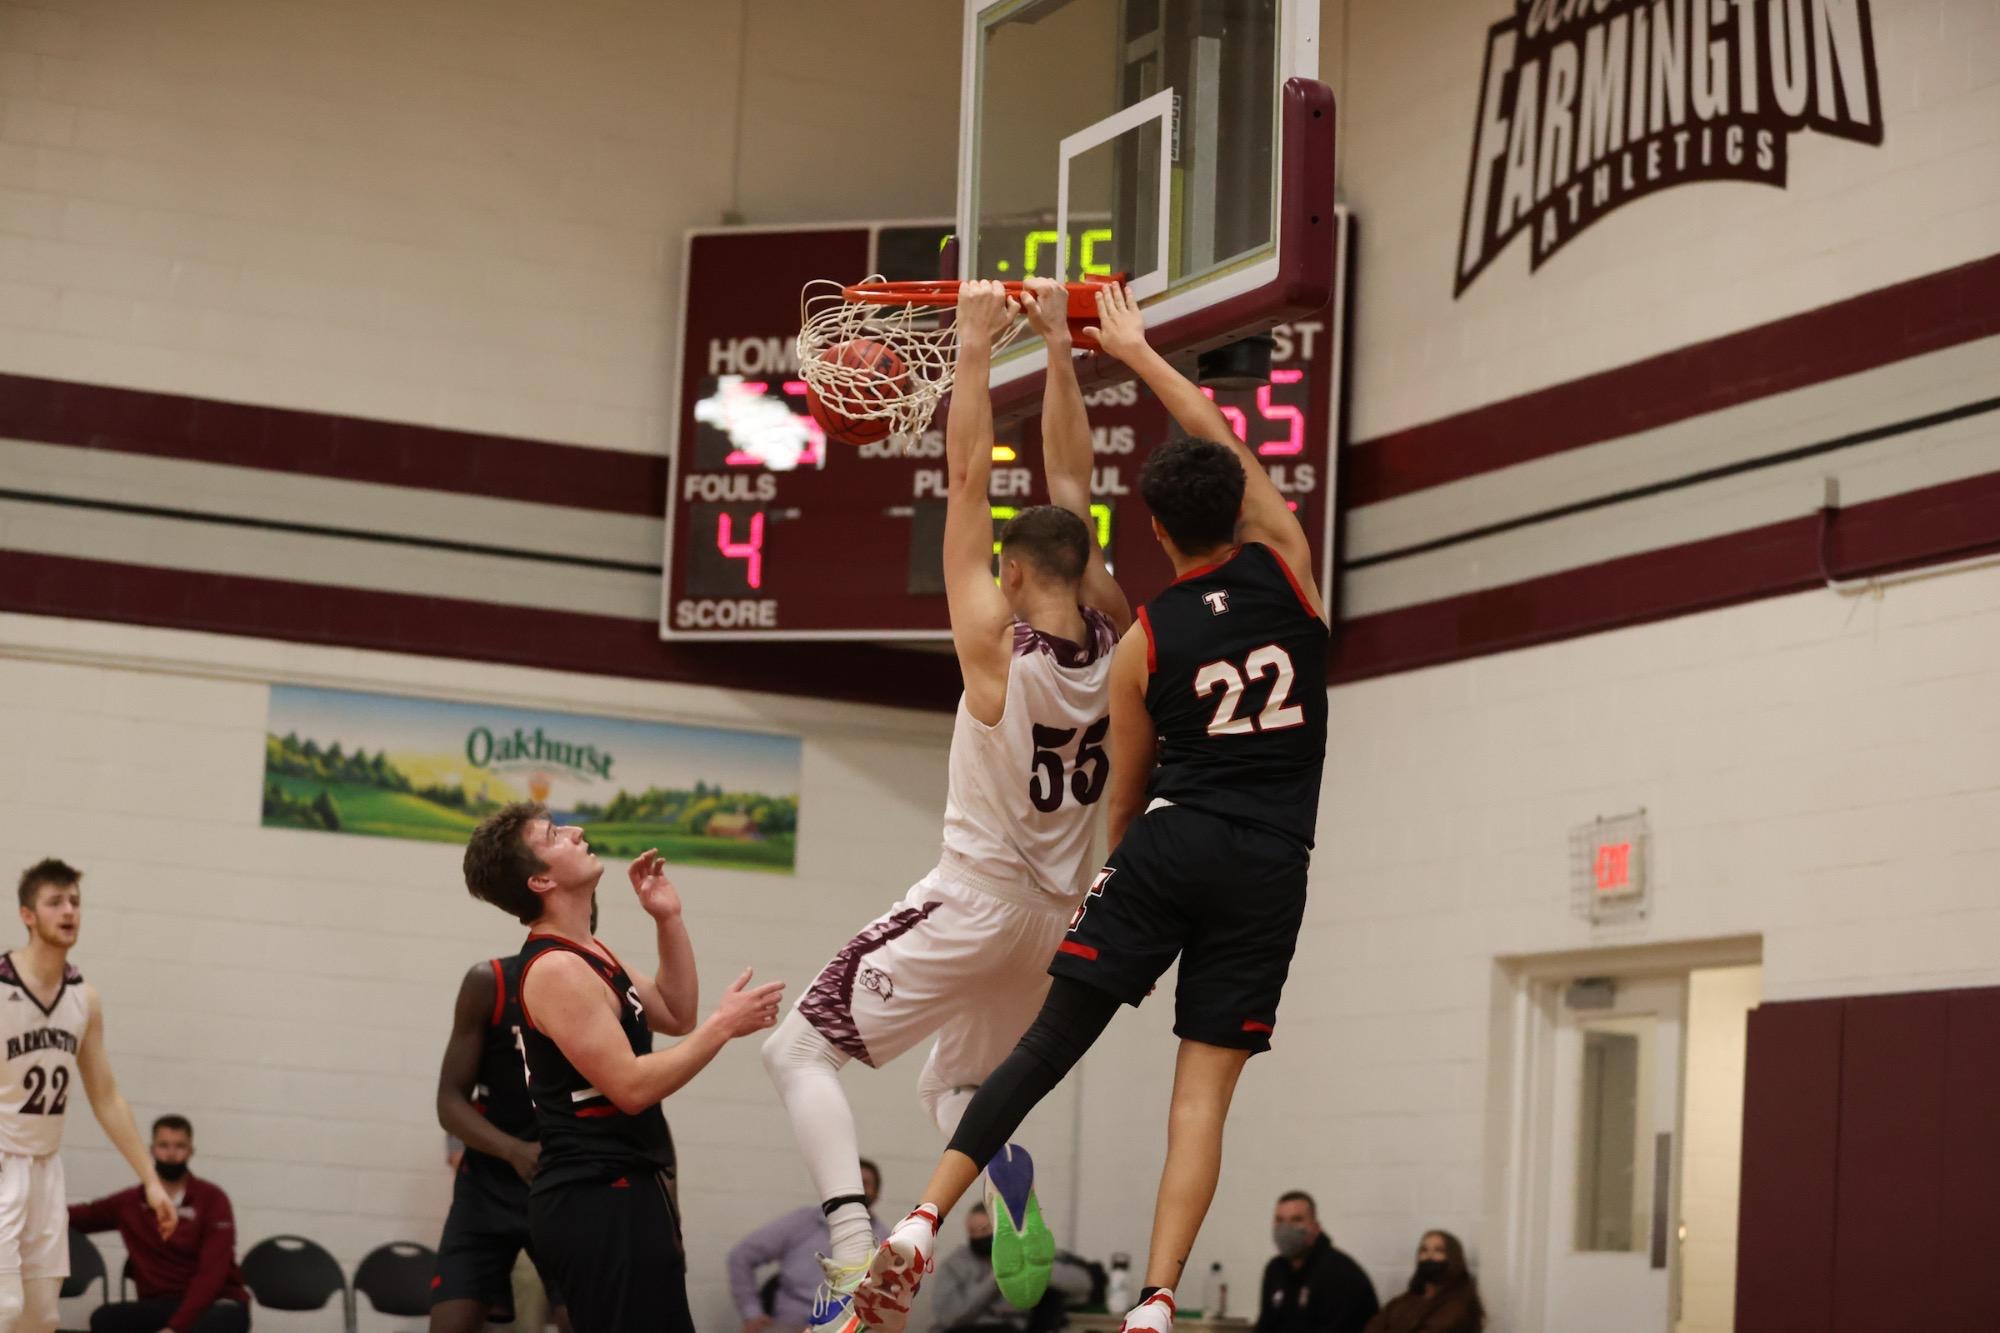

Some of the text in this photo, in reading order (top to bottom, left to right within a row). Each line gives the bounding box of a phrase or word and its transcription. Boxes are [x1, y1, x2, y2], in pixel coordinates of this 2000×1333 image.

[1462, 0, 1872, 277] FARMINGTON
[1541, 125, 1775, 253] ATHLETICS
[708, 336, 800, 375] HOM
[683, 473, 776, 501] FOULS
[717, 511, 764, 589] 4
[676, 600, 778, 627] SCORE
[1203, 589, 1230, 616] T
[1194, 643, 1305, 737] 22
[466, 726, 616, 780] Oakhurst
[1029, 716, 1110, 813] 55
[17, 1065, 70, 1116] 22
